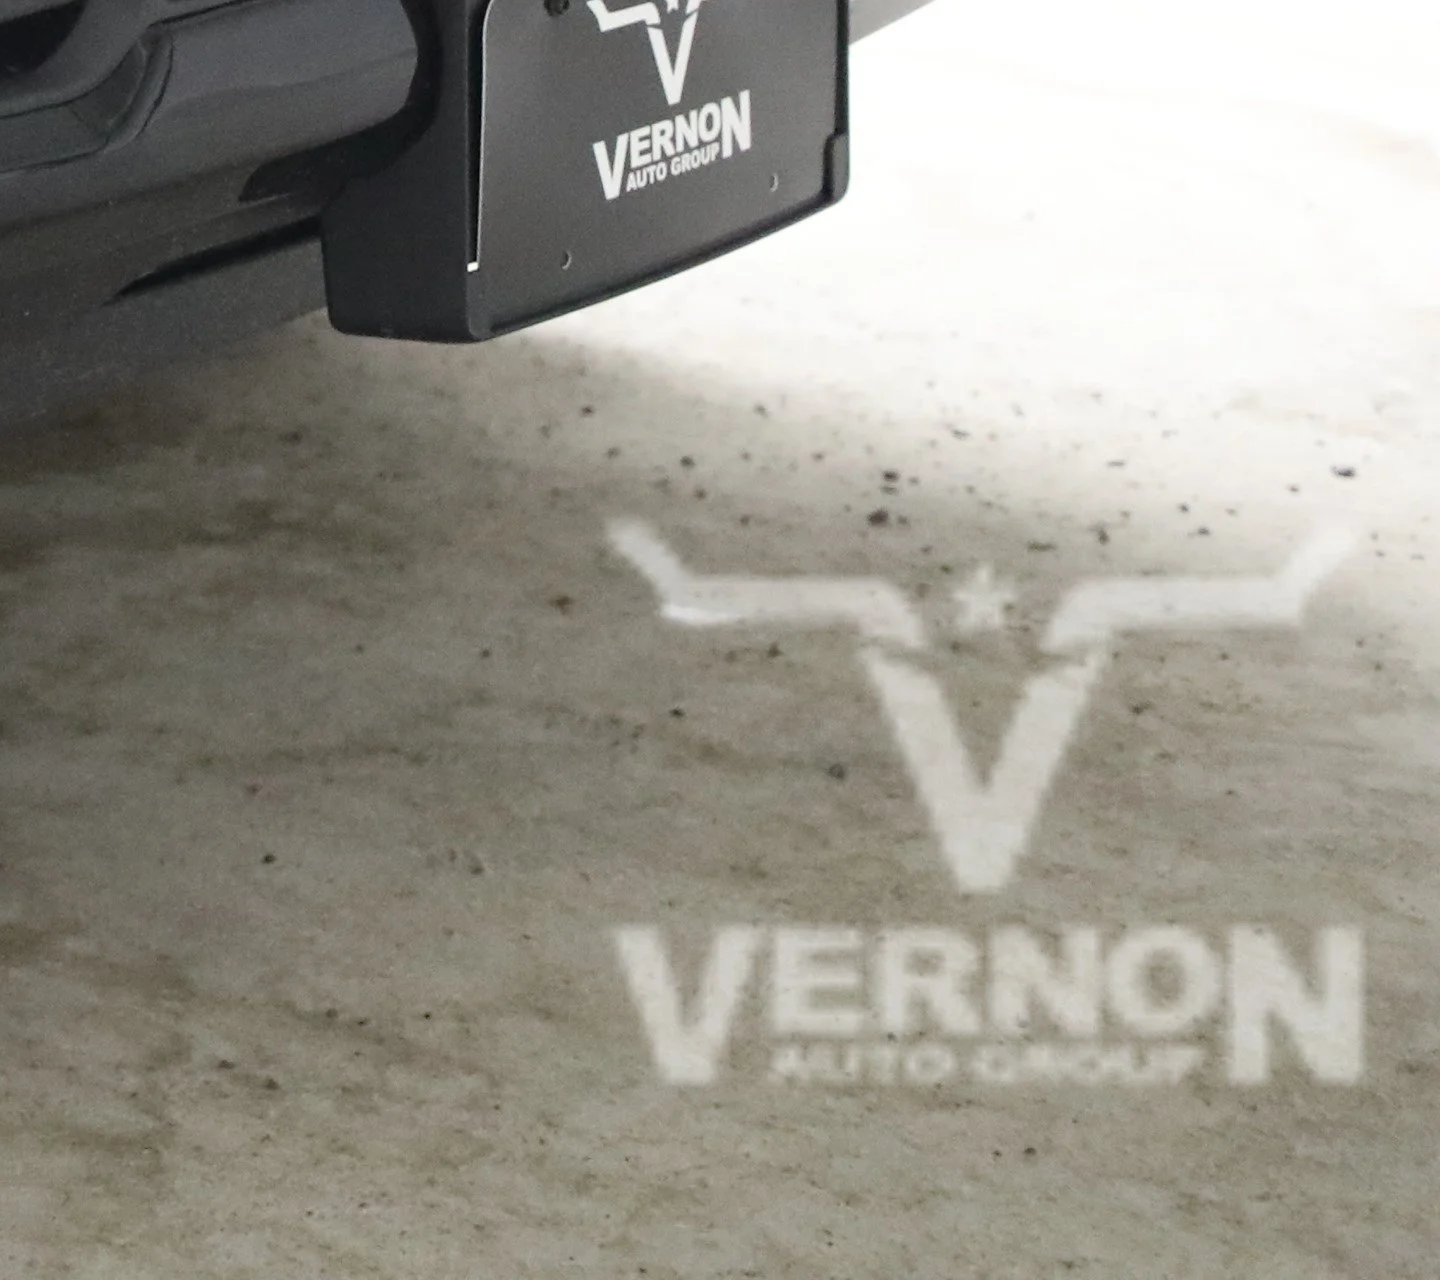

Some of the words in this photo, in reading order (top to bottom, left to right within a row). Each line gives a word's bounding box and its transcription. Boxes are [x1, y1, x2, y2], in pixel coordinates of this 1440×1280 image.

[592, 89, 752, 201] VERNON
[626, 161, 668, 193] AUTO
[670, 141, 721, 177] GROUP
